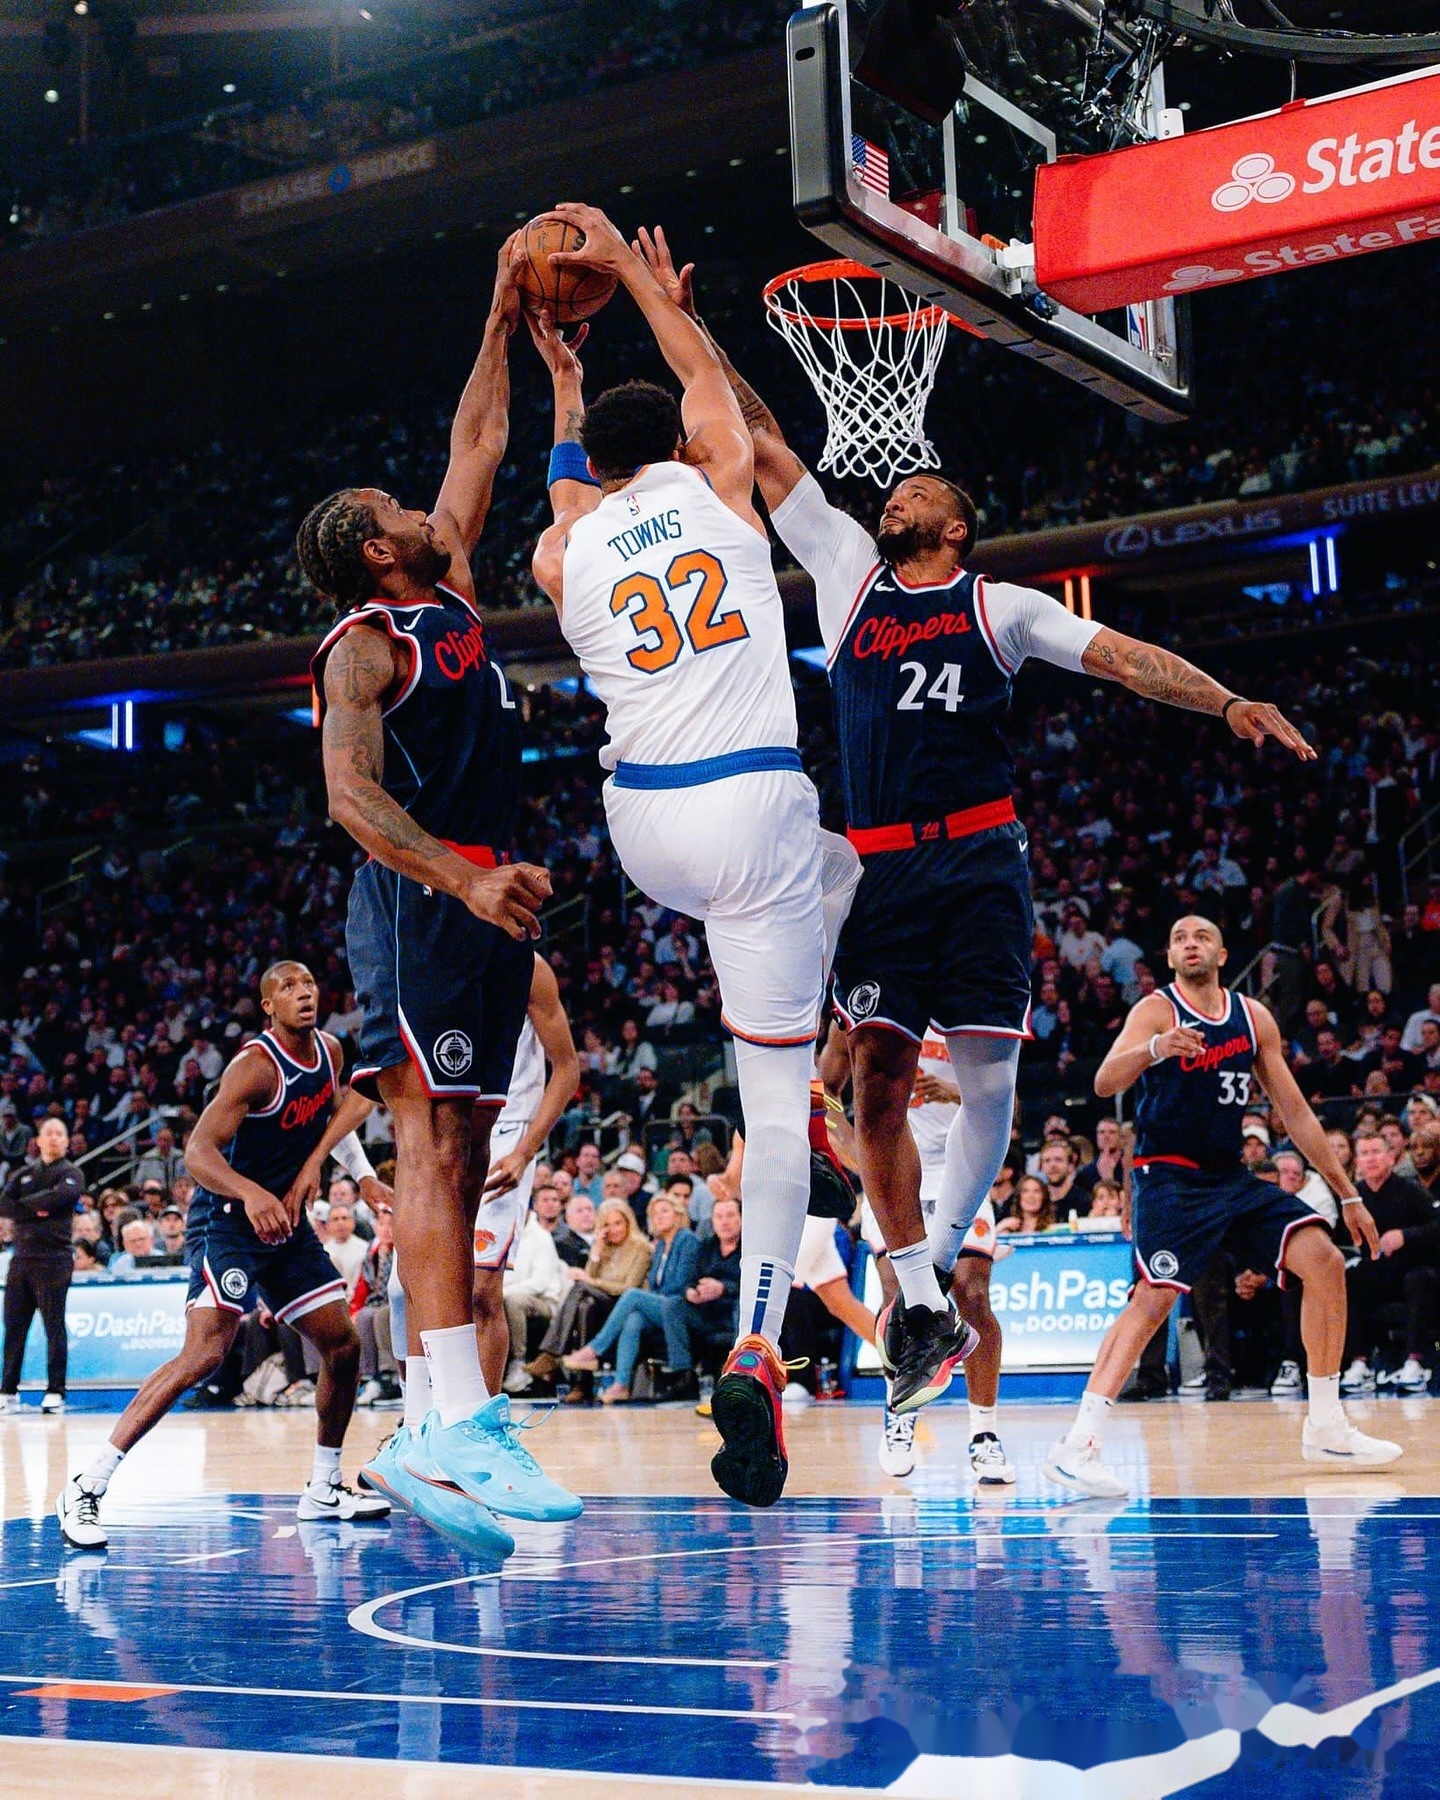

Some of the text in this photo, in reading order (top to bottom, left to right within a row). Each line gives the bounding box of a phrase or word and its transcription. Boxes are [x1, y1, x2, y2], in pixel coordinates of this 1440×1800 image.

[1302, 119, 1440, 194] State
[1244, 231, 1394, 272] State
[1153, 508, 1281, 546] LEXUS
[1323, 489, 1391, 520] SUITE
[607, 509, 682, 562] TOWNS
[609, 548, 750, 675] 32
[853, 612, 972, 660] Clippers
[897, 661, 964, 712] 24
[1217, 1071, 1251, 1106] 33
